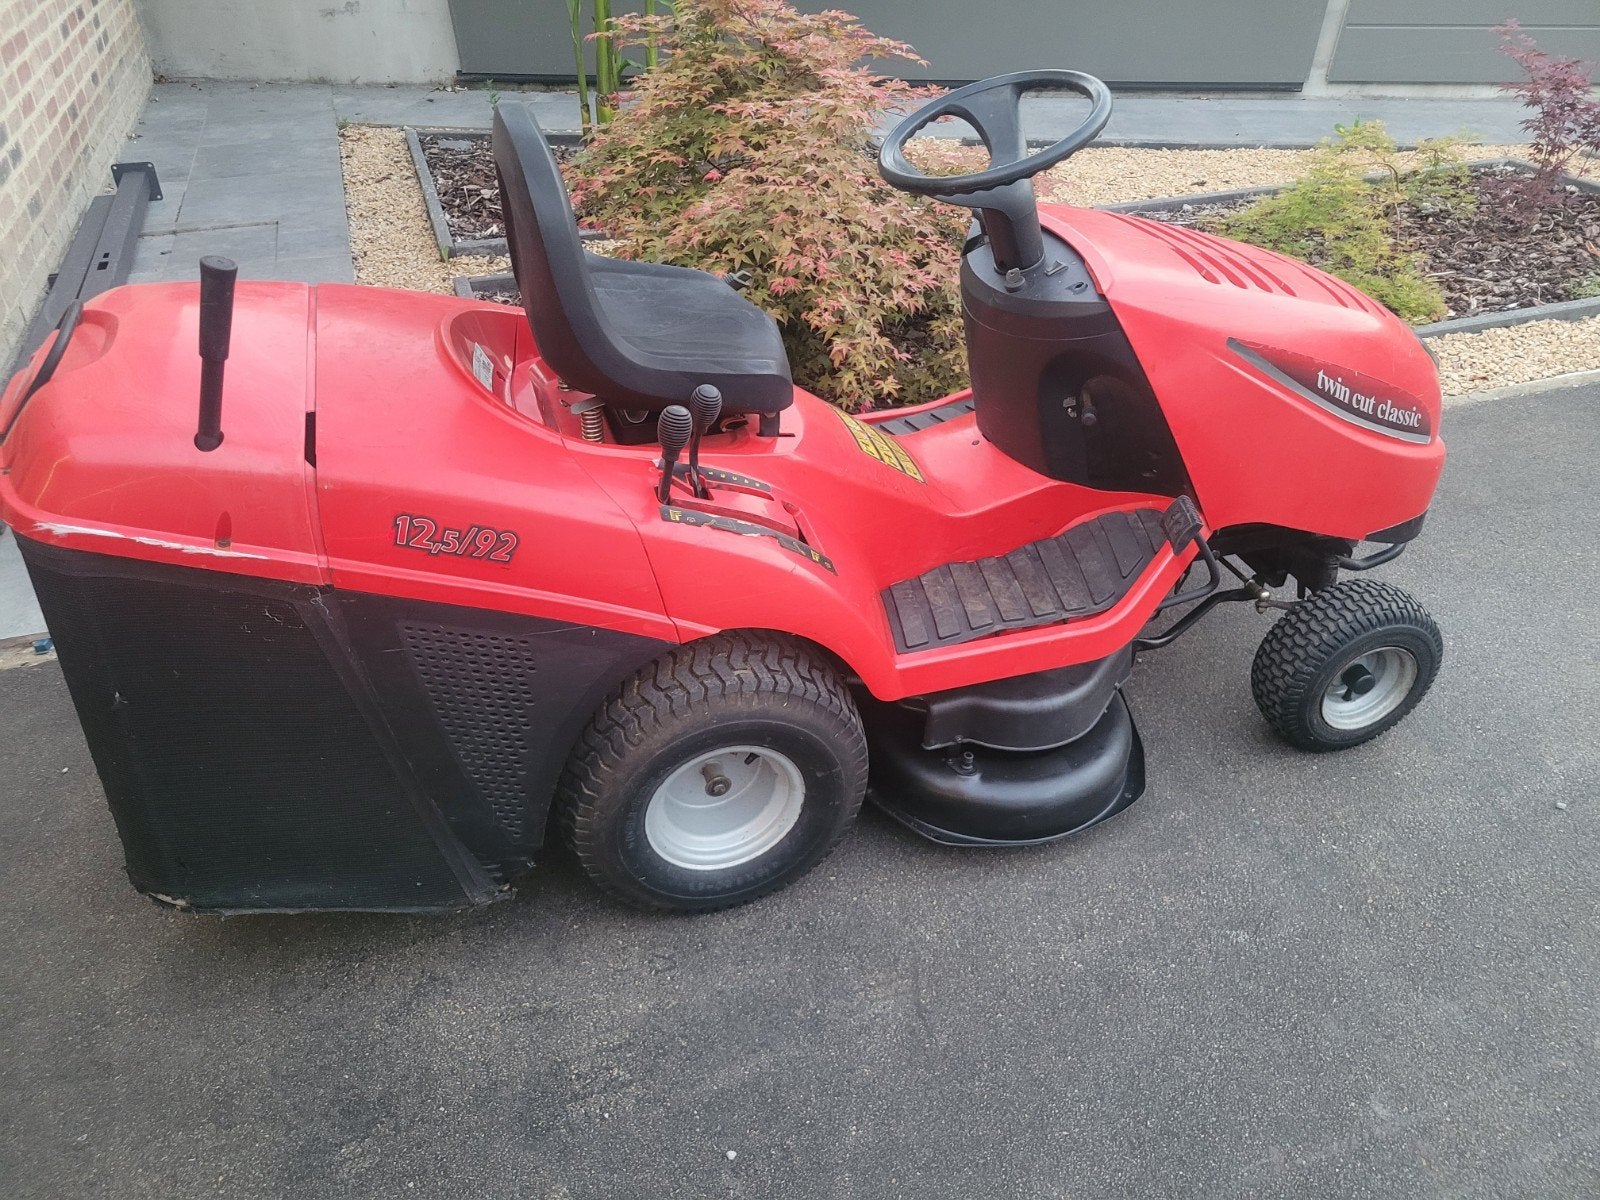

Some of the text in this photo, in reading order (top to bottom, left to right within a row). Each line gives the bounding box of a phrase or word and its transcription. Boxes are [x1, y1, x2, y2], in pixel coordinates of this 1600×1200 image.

[1317, 368, 1422, 428] twin cut classic
[395, 515, 518, 562] 12,5/92
